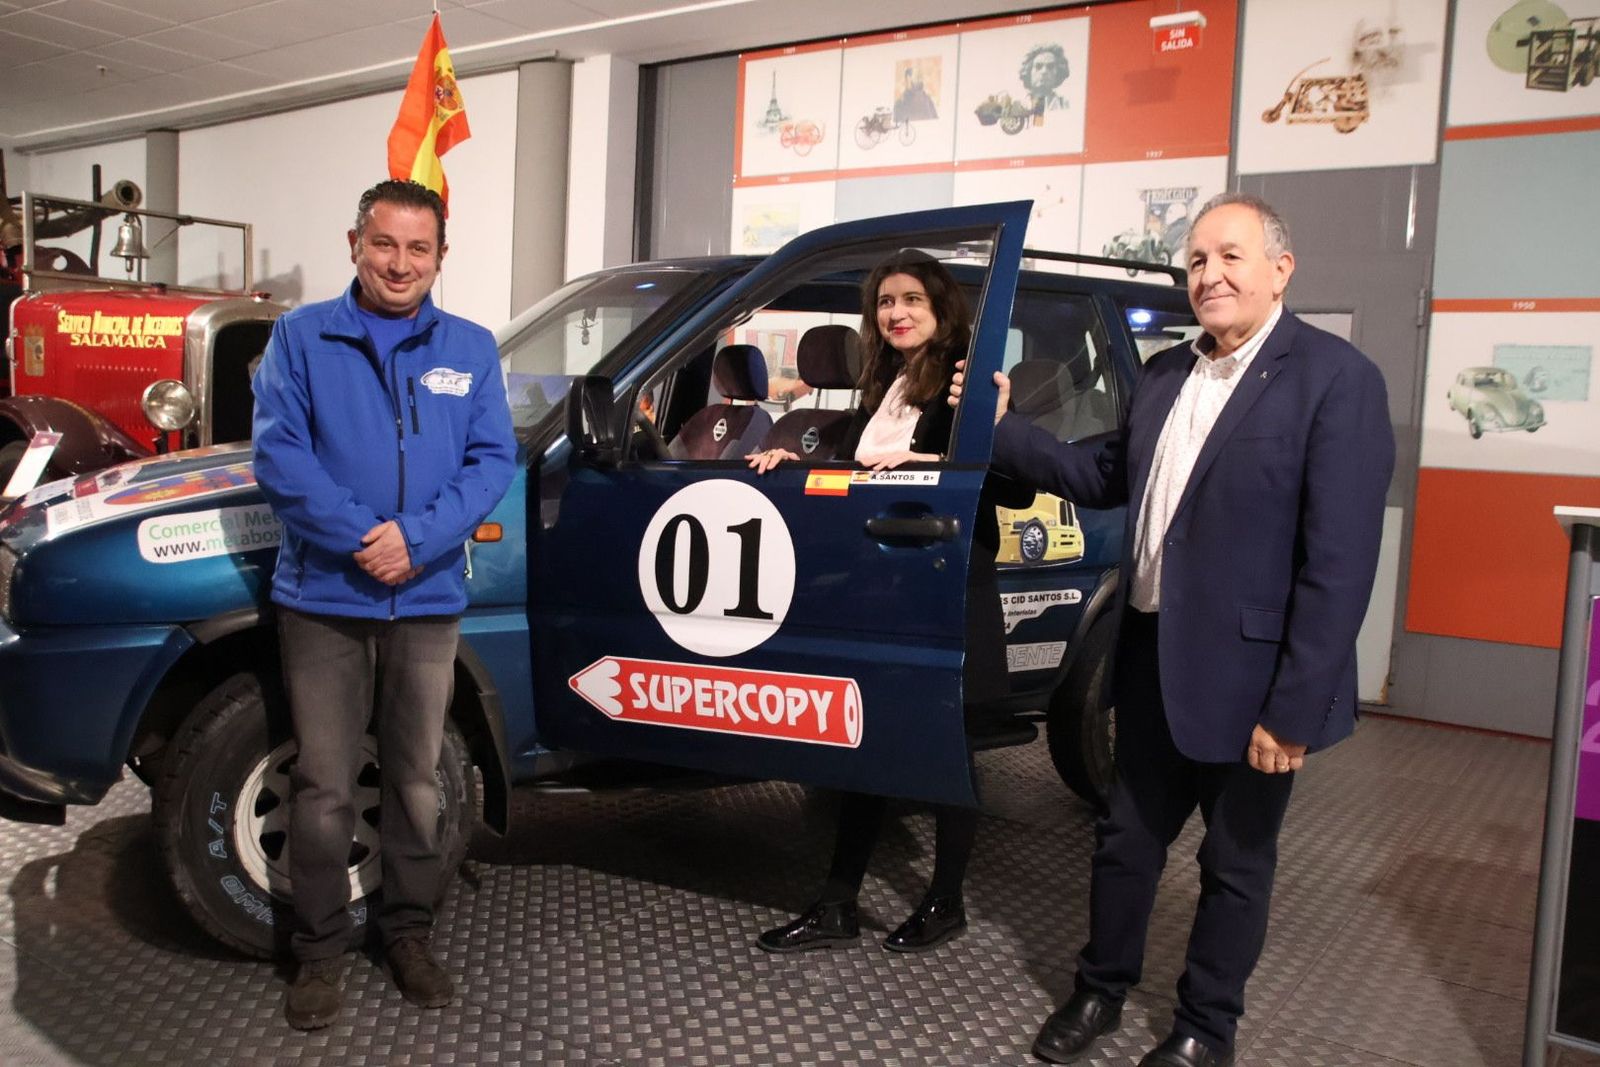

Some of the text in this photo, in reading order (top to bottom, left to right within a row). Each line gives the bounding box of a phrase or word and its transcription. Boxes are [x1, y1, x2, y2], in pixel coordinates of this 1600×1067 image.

[1169, 27, 1186, 40] SIN
[1160, 38, 1194, 52] SALIDA
[70, 333, 167, 349] SALAMANCA
[655, 513, 774, 620] 01
[1010, 596, 1026, 605] CID
[1028, 593, 1062, 603] SANTOS
[1063, 592, 1079, 600] S.L.
[629, 672, 833, 734] SUPERCOPY
